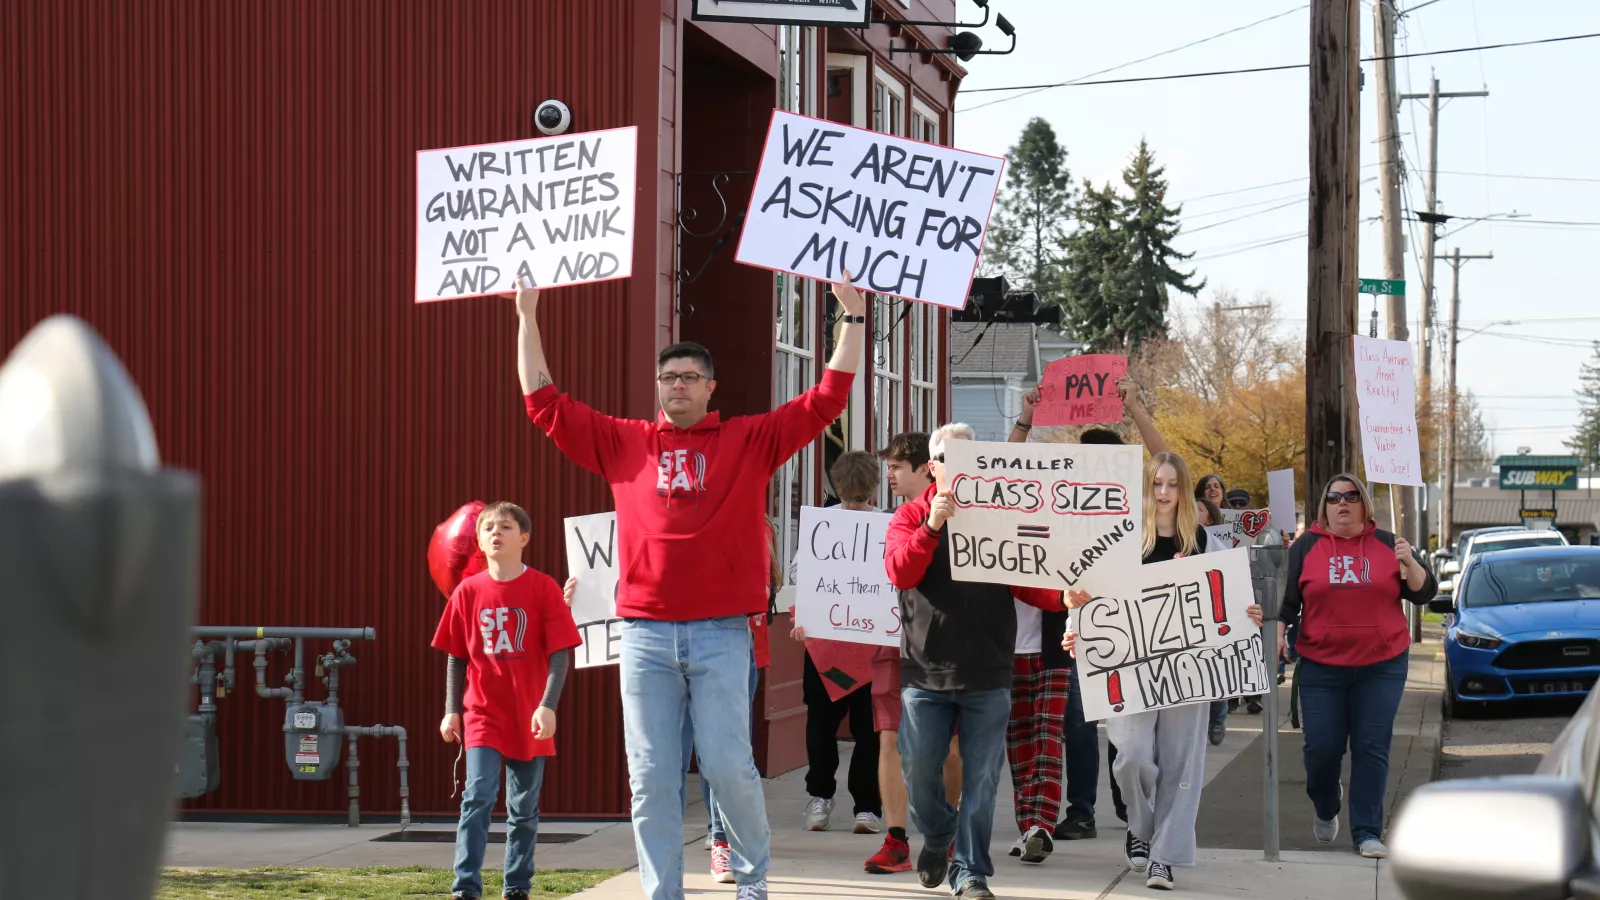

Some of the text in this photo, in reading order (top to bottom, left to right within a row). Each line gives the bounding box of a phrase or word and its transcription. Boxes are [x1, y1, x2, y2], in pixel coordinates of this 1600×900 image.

[445, 138, 602, 182] WRITTEN
[783, 124, 994, 202] WE AREN'T
[425, 172, 620, 223] GUARANTEES
[761, 176, 982, 256] ASKING FOR
[441, 206, 626, 258] NOT A WINK
[437, 252, 619, 296] AND A NOD
[790, 233, 927, 298] MUCH
[1358, 280, 1392, 293] Park St
[1360, 346, 1379, 361] Class
[1065, 372, 1109, 400] PAY
[1364, 380, 1399, 404] Reality!
[1070, 403, 1093, 420] ME
[660, 449, 688, 472] SF
[977, 456, 1074, 470] SMALLER
[656, 466, 692, 491] EA
[1502, 470, 1574, 486] SUBWAY
[955, 477, 1123, 511] CLASS SIZE
[811, 520, 870, 563] Call
[952, 532, 1050, 576] BIGGER
[1057, 519, 1135, 587] LEARNING
[1329, 555, 1354, 570] SF
[1329, 569, 1360, 584] EA
[815, 577, 842, 595] Ask
[847, 577, 880, 596] them
[480, 607, 509, 632] SF
[829, 603, 875, 631] Class
[1079, 569, 1231, 669] SIZE!
[481, 630, 514, 655] EA
[1135, 633, 1270, 710] MATTER
